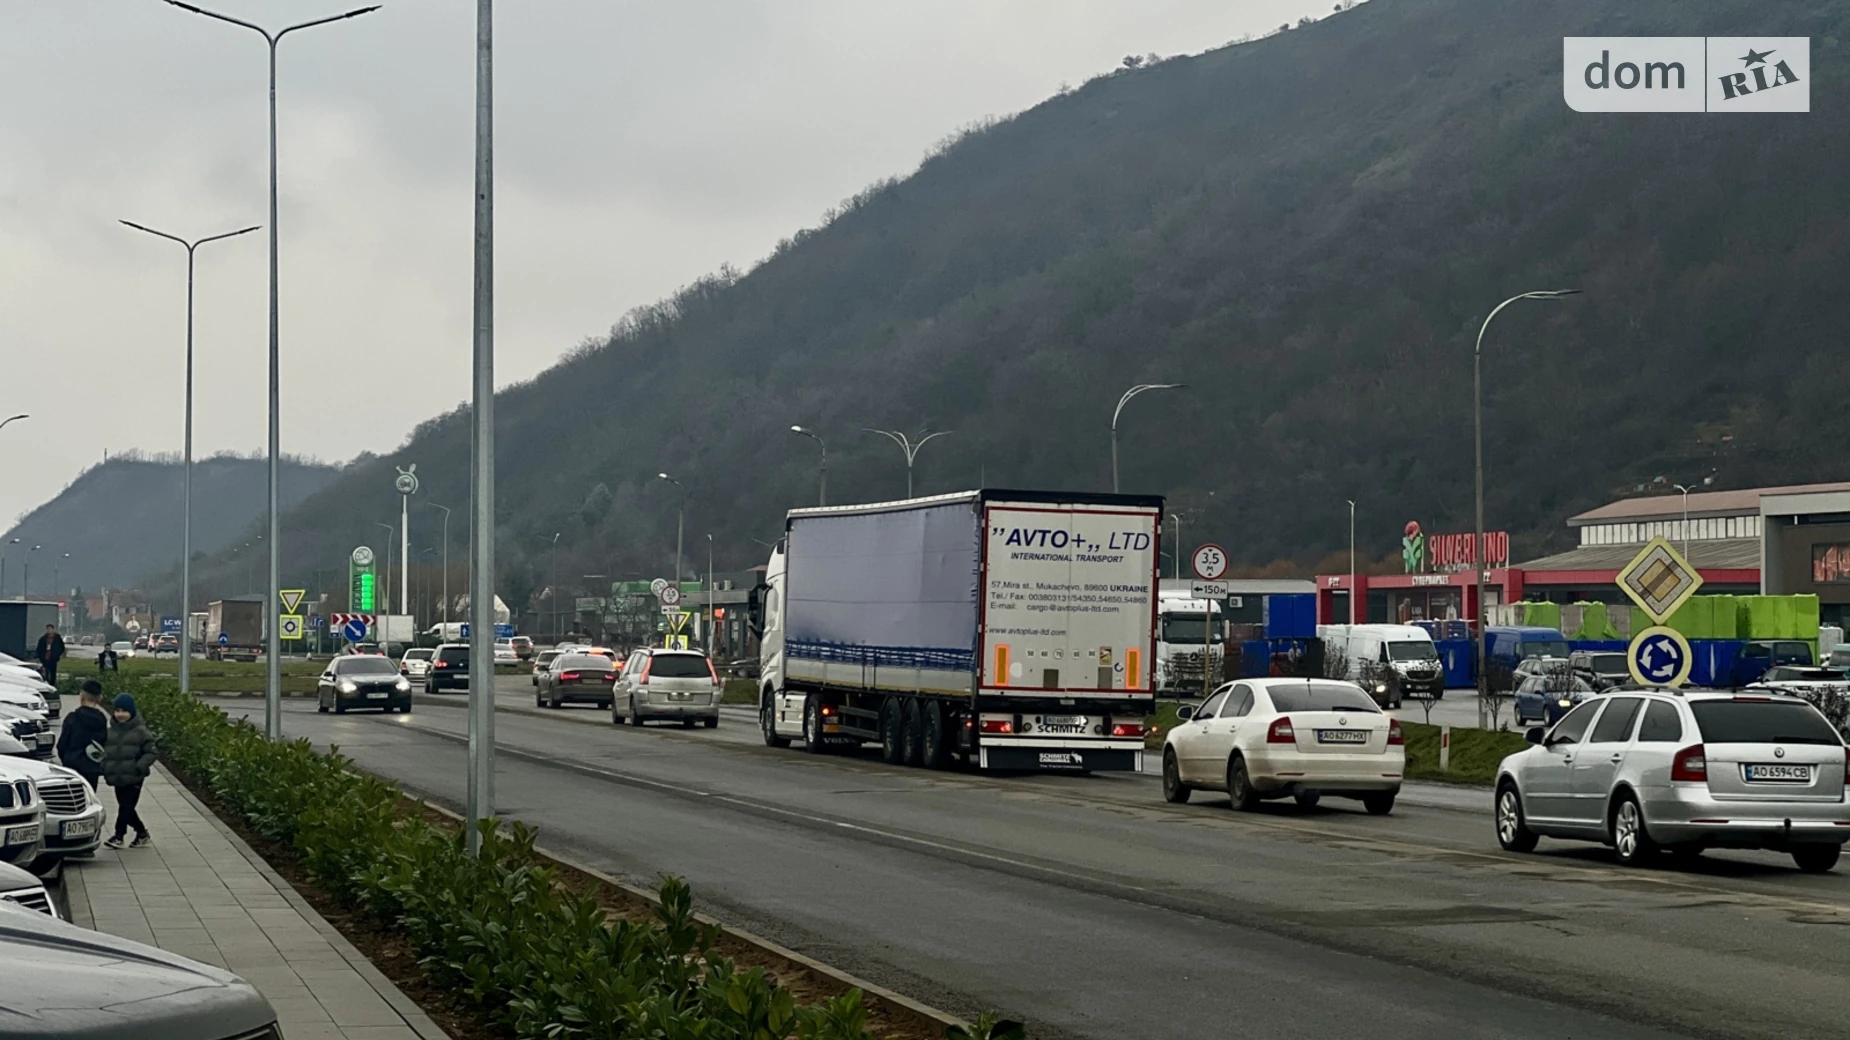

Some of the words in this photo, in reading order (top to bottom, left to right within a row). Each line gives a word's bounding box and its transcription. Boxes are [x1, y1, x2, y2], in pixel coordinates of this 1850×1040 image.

[1108, 531, 1151, 551] LTD
[1429, 531, 1507, 565] SILVERLND
[1010, 552, 1073, 562] INTERNATIONAL
[1076, 554, 1124, 563] TRANSPORT
[1202, 552, 1220, 565] 3,5
[1110, 584, 1148, 593] UKRAINE
[1037, 724, 1086, 734] SCHMITZ
[1753, 765, 1768, 776] AO
[1769, 765, 1792, 777] 6594
[1793, 766, 1808, 778] CB
